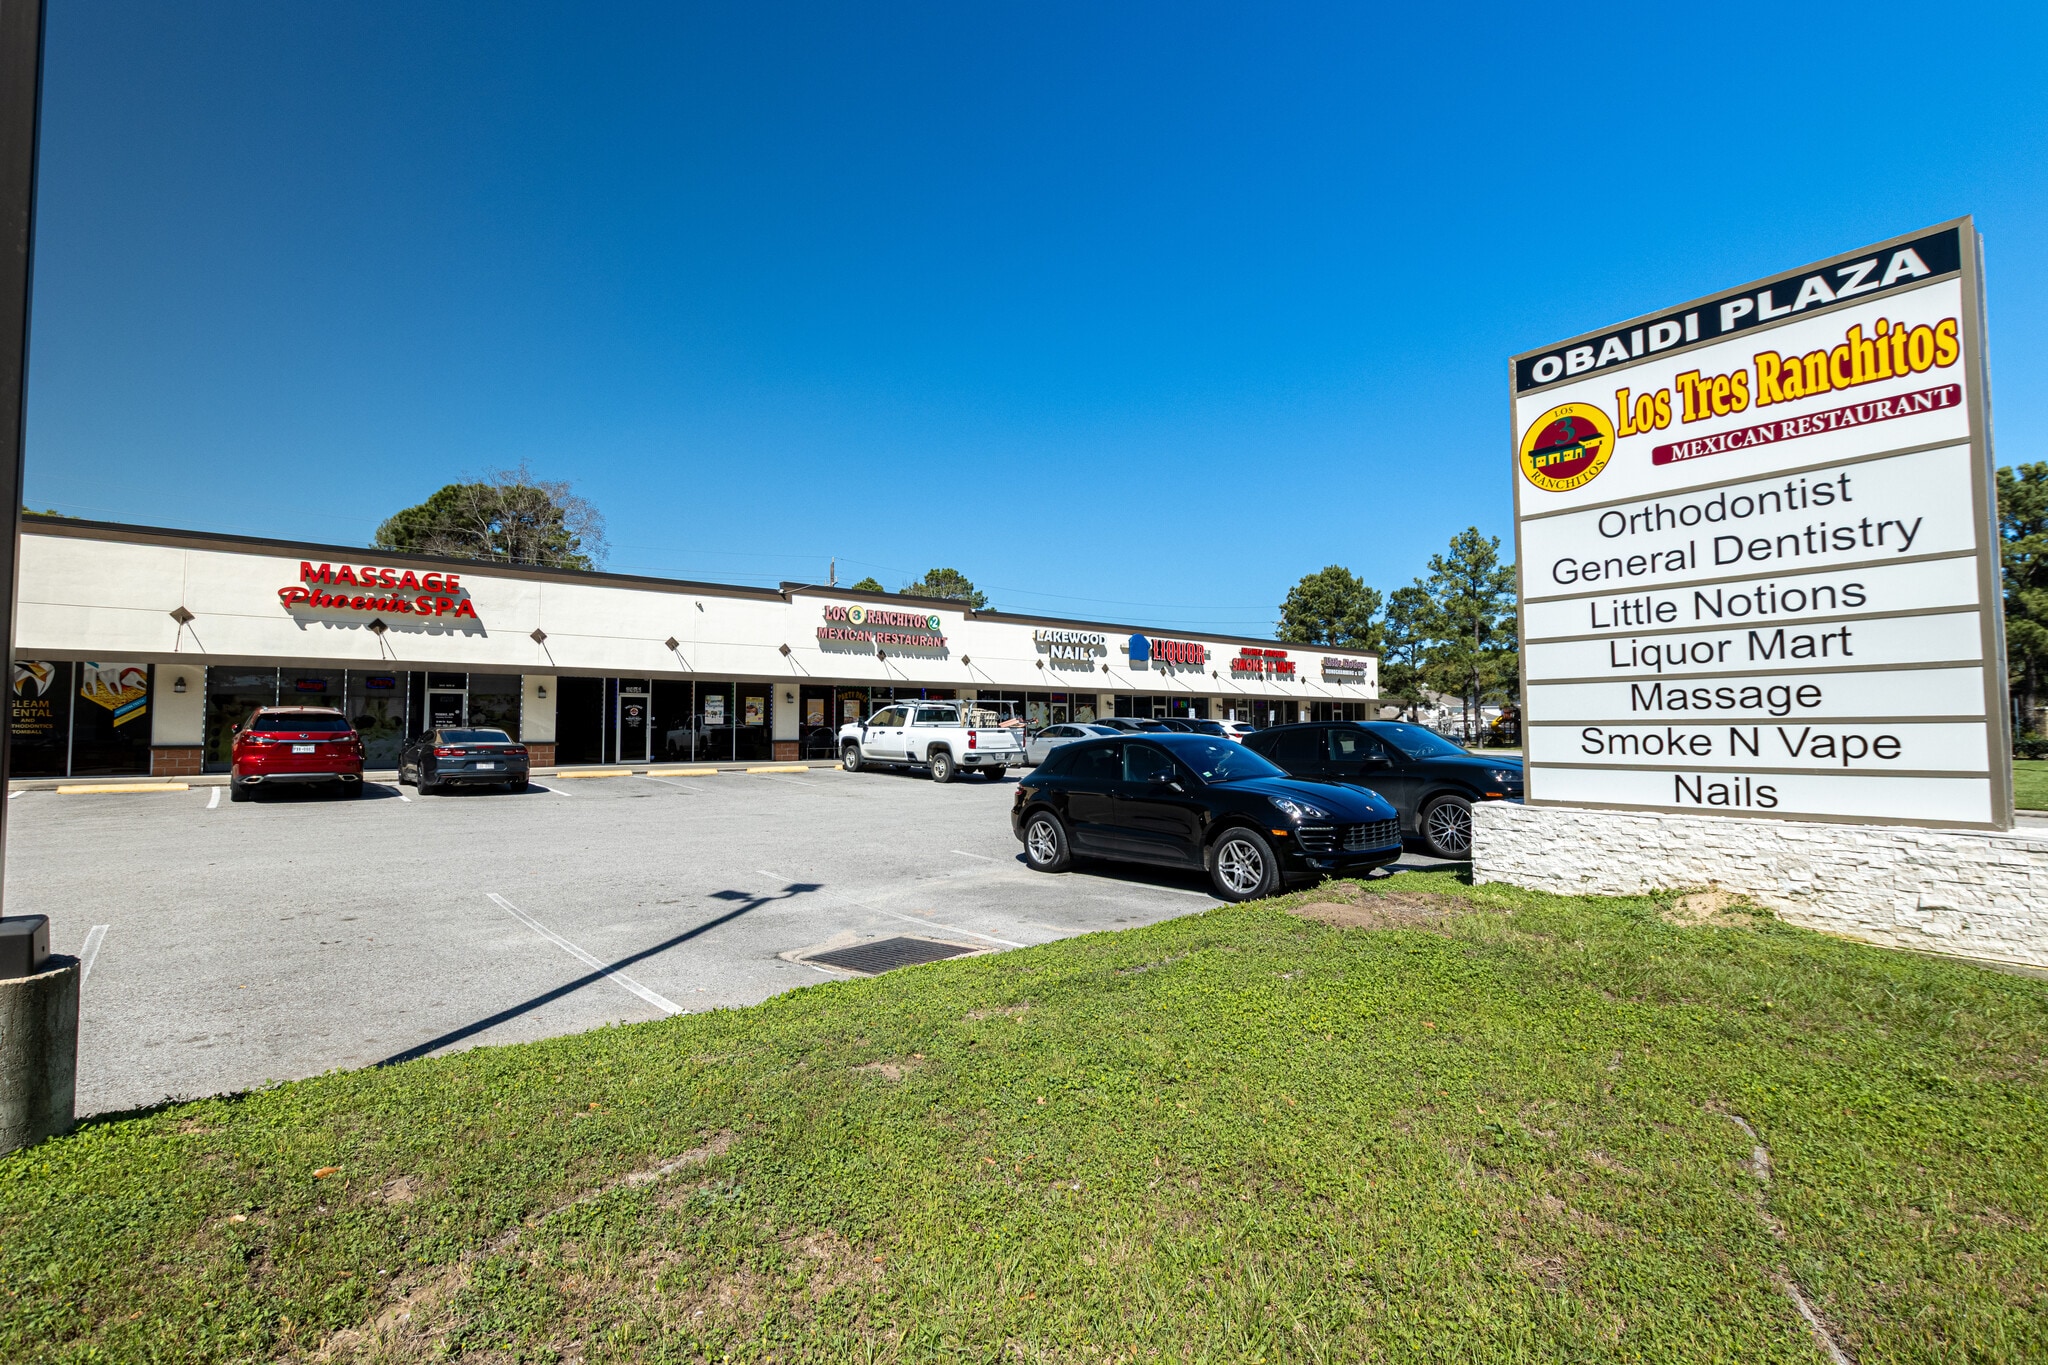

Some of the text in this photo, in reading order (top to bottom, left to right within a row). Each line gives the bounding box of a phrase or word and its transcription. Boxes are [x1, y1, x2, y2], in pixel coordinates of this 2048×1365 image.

[1532, 248, 1930, 383] OBAIDI PLAZA
[1616, 317, 1960, 437] Los Tres Ranchitos
[1554, 406, 1574, 417] LOS
[1672, 386, 1954, 461] MEXICAN RESTAURANT
[1554, 416, 1576, 445] 3
[1531, 459, 1605, 489] RANCHITOS
[1599, 473, 1852, 539] Orthodontist
[1552, 516, 1923, 585] General Dentistry
[300, 561, 460, 595] MASSAGE
[277, 586, 477, 619] Phoenix SPA
[824, 605, 847, 621] LOS
[852, 610, 861, 621] 3
[866, 609, 927, 629] RANCHITOS
[1591, 582, 1866, 629] Little Notions
[817, 626, 948, 647] MEXICAN RESTAURANT
[1035, 629, 1107, 646] LAKEWOOD
[1050, 645, 1095, 661] NAILS
[1152, 639, 1205, 667] LIQUOR
[1610, 626, 1853, 673] Liquor Mart
[1231, 658, 1296, 674] SMOKE N VAPE
[12, 708, 53, 717] ENTAL
[1631, 682, 1822, 716] Massage
[1581, 726, 1901, 767] Smoke N Vape
[1675, 774, 1778, 808] Nails
